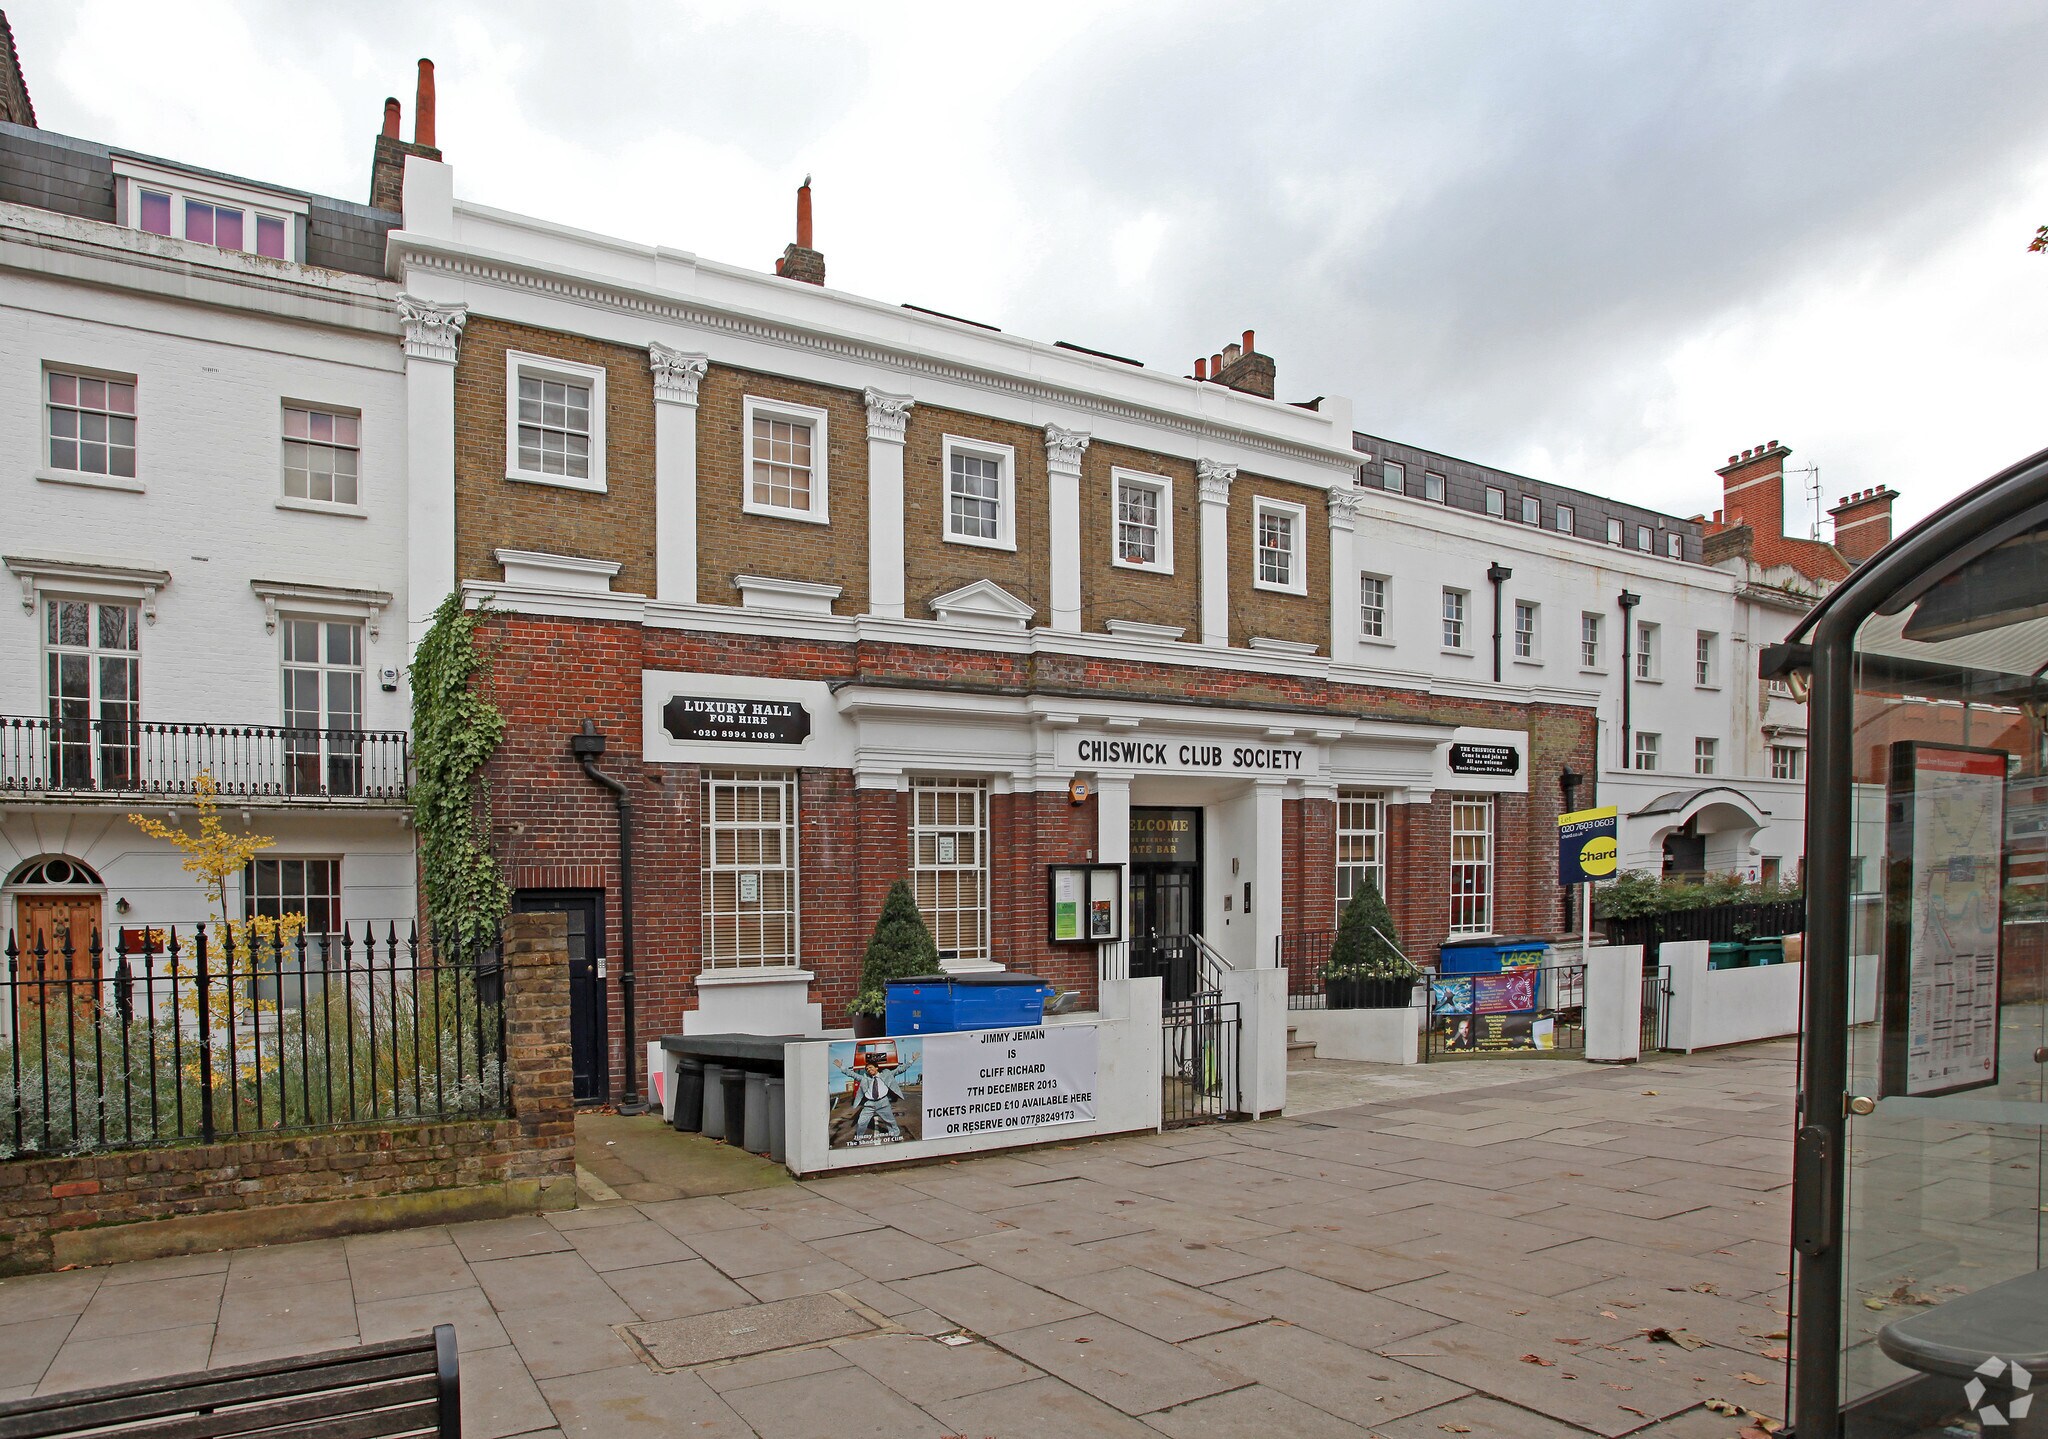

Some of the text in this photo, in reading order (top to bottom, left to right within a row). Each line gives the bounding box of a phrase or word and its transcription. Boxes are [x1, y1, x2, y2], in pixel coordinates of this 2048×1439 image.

[684, 700, 792, 717] LUXURY HALL
[709, 714, 768, 725] FOR HIRE
[698, 729, 776, 740] 020 8994 1089
[1078, 739, 1303, 770] CHISWICK CLUB SOCIETY
[1471, 746, 1496, 754] CHISWICK
[1130, 819, 1189, 832] ELCOME
[1561, 818, 1614, 834] 020 7603 0603
[1131, 845, 1177, 854] ATE BAR
[1579, 848, 1617, 863] Chard
[981, 1029, 1045, 1044] JIMMY JEMAIN
[1007, 1049, 1017, 1059] IS
[979, 1063, 1046, 1078] CLIFF RICHARD
[967, 1079, 1057, 1097] 7TH DECEMBER 2013
[927, 1092, 1092, 1118] TICKETS PRICED £10 AVAILABLE HERE
[946, 1110, 1075, 1134] OR RESERVE ON 07788249173
